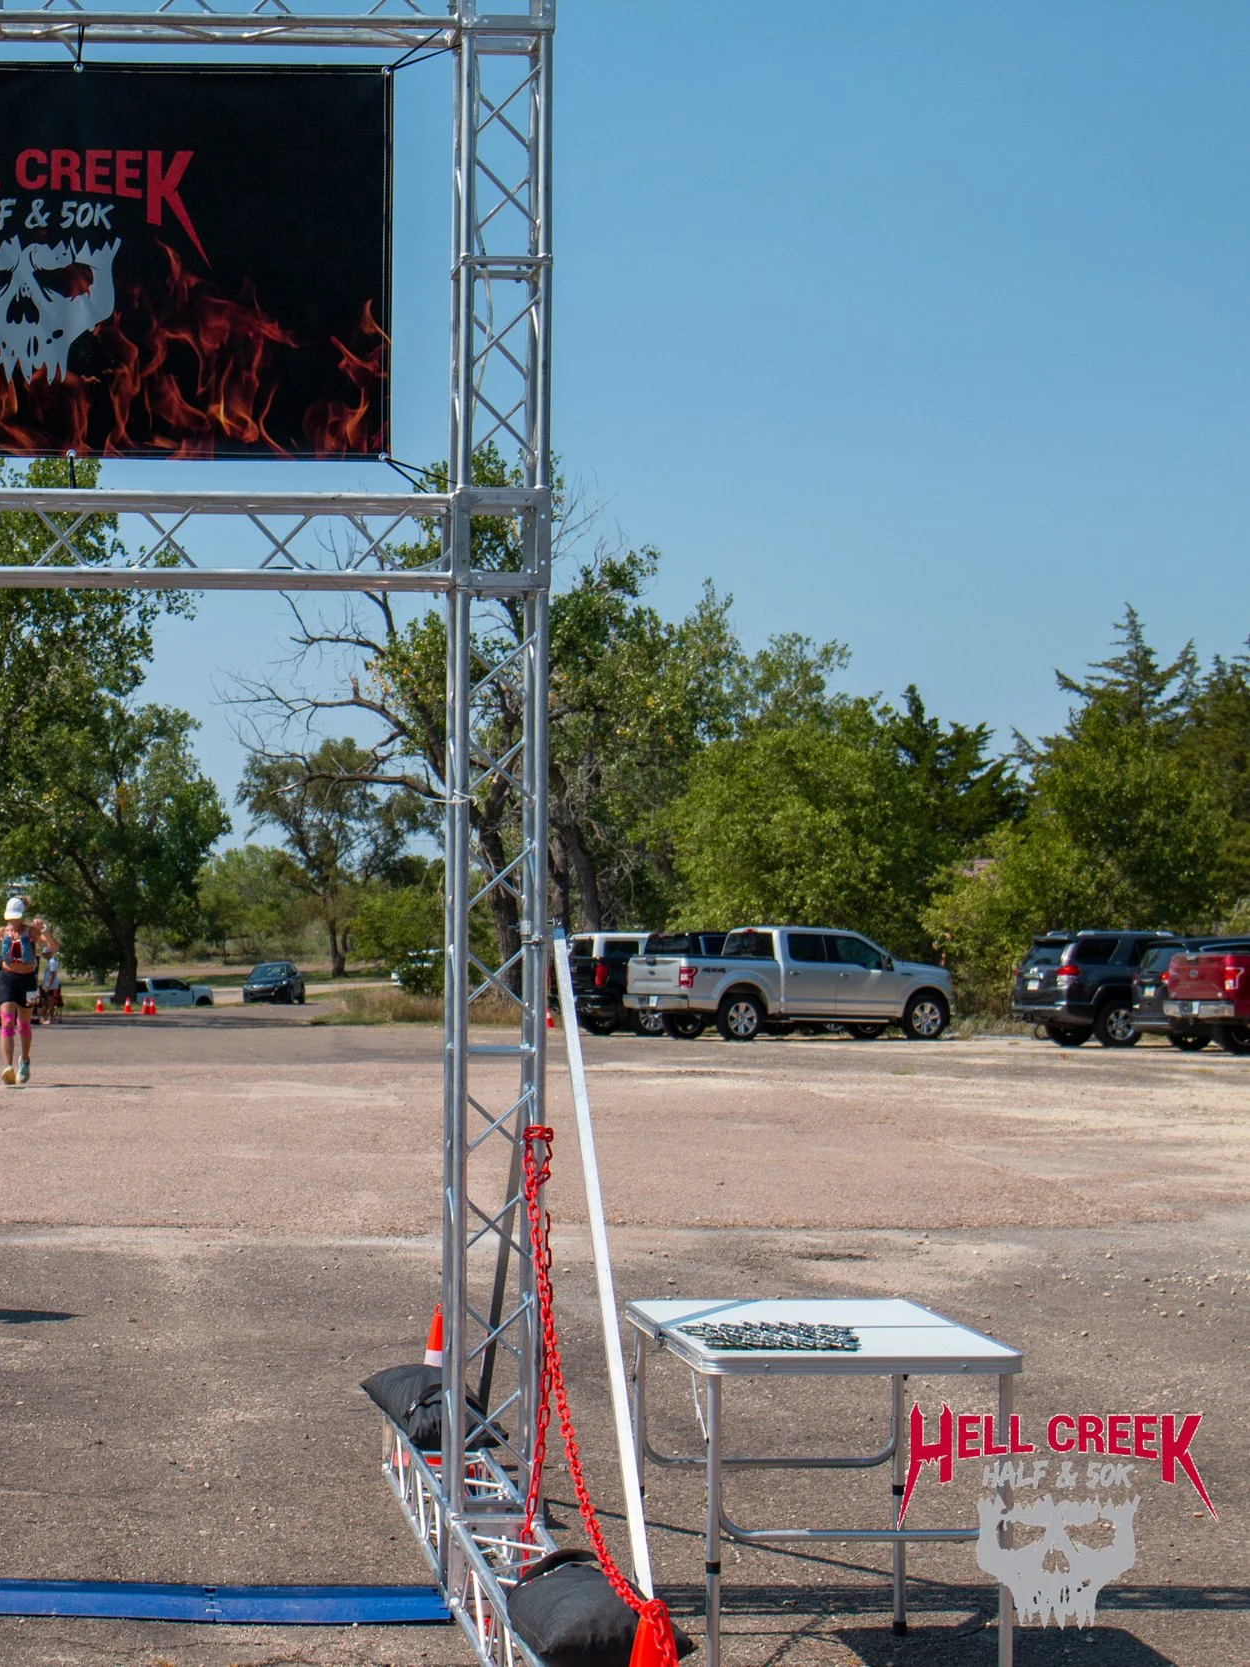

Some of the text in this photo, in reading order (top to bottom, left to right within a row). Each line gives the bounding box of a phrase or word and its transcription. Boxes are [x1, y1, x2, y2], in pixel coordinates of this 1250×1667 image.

[15, 148, 212, 270] CREEK
[25, 198, 50, 229] &
[58, 201, 116, 230] 50K
